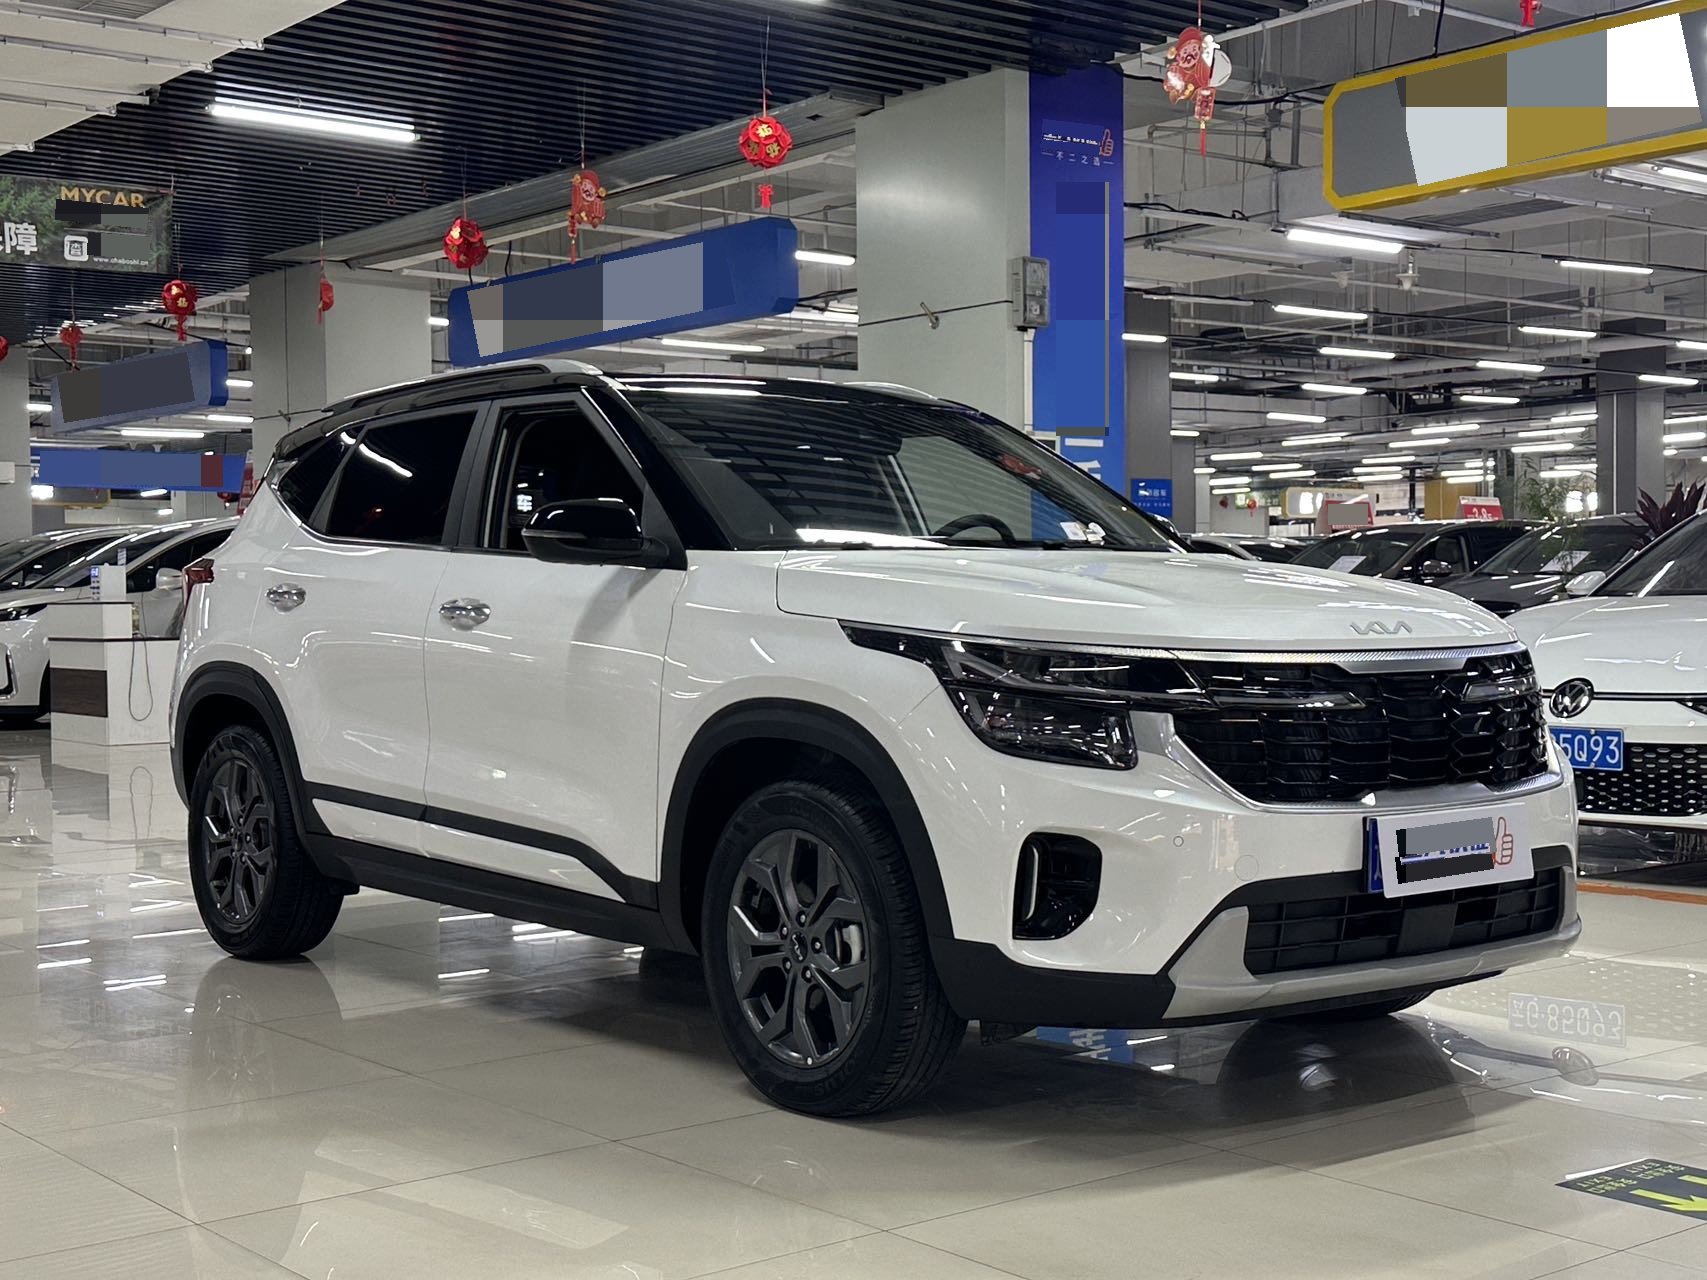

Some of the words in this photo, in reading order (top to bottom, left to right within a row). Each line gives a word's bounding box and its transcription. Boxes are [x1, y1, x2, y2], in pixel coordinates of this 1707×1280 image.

[60, 186, 146, 208] MYCAR
[0, 222, 39, 256] 障
[1553, 733, 1620, 764] 5Q93
